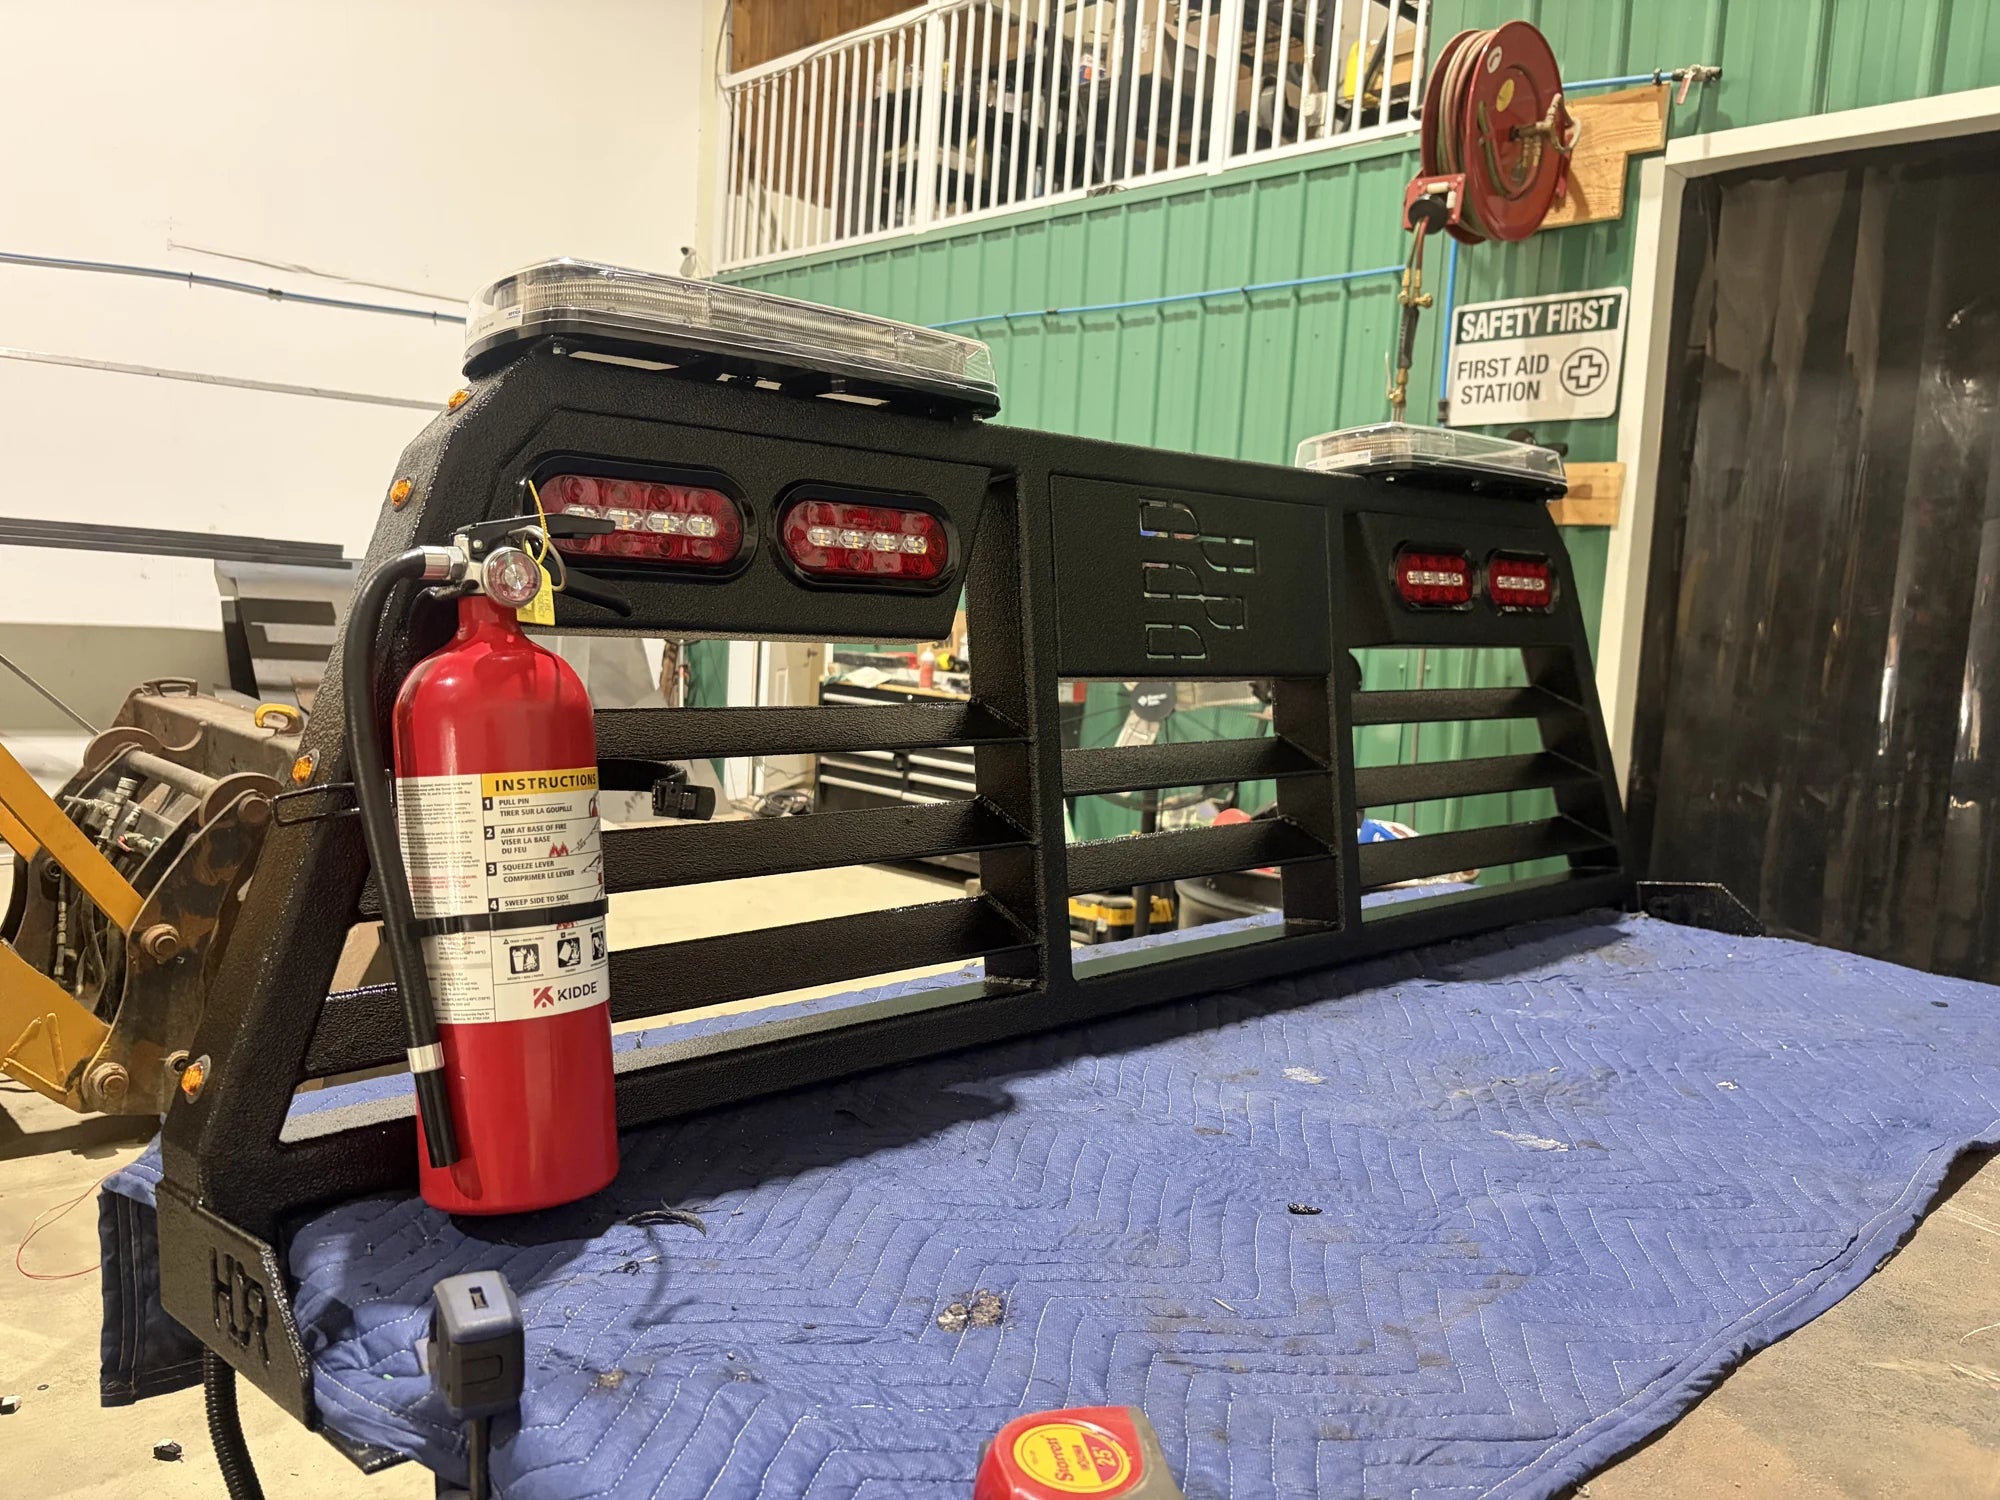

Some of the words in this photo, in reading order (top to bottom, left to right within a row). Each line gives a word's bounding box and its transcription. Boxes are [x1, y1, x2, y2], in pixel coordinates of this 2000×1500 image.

[1461, 305, 1542, 341] SAFETY
[1546, 298, 1615, 333] FIRST
[1457, 357, 1511, 380] FIRST
[1515, 354, 1549, 375] AID
[1461, 380, 1541, 405] STATION
[495, 774, 596, 791] INSTRUCTIONS
[484, 799, 491, 809] 1
[500, 809, 520, 817] TIRER
[546, 805, 573, 814] GOUPILLE
[486, 828, 493, 838] 2
[500, 827, 515, 835] AIM
[516, 826, 525, 834] AT
[527, 825, 544, 833] BASE
[555, 823, 567, 831] FIRE
[501, 838, 522, 846] VISER
[523, 836, 533, 844] LA
[534, 835, 551, 843] BASE
[514, 846, 527, 854] FEU
[488, 865, 495, 874] 3
[502, 862, 533, 871] SQUEEZE
[534, 860, 555, 868] LEVER
[503, 873, 546, 883] COMPRIMER
[556, 869, 575, 878] LEVIER
[490, 901, 498, 910] 4
[504, 898, 528, 907] SWEEP
[530, 897, 545, 905] SIDE
[557, 982, 597, 1002] KIDDE
